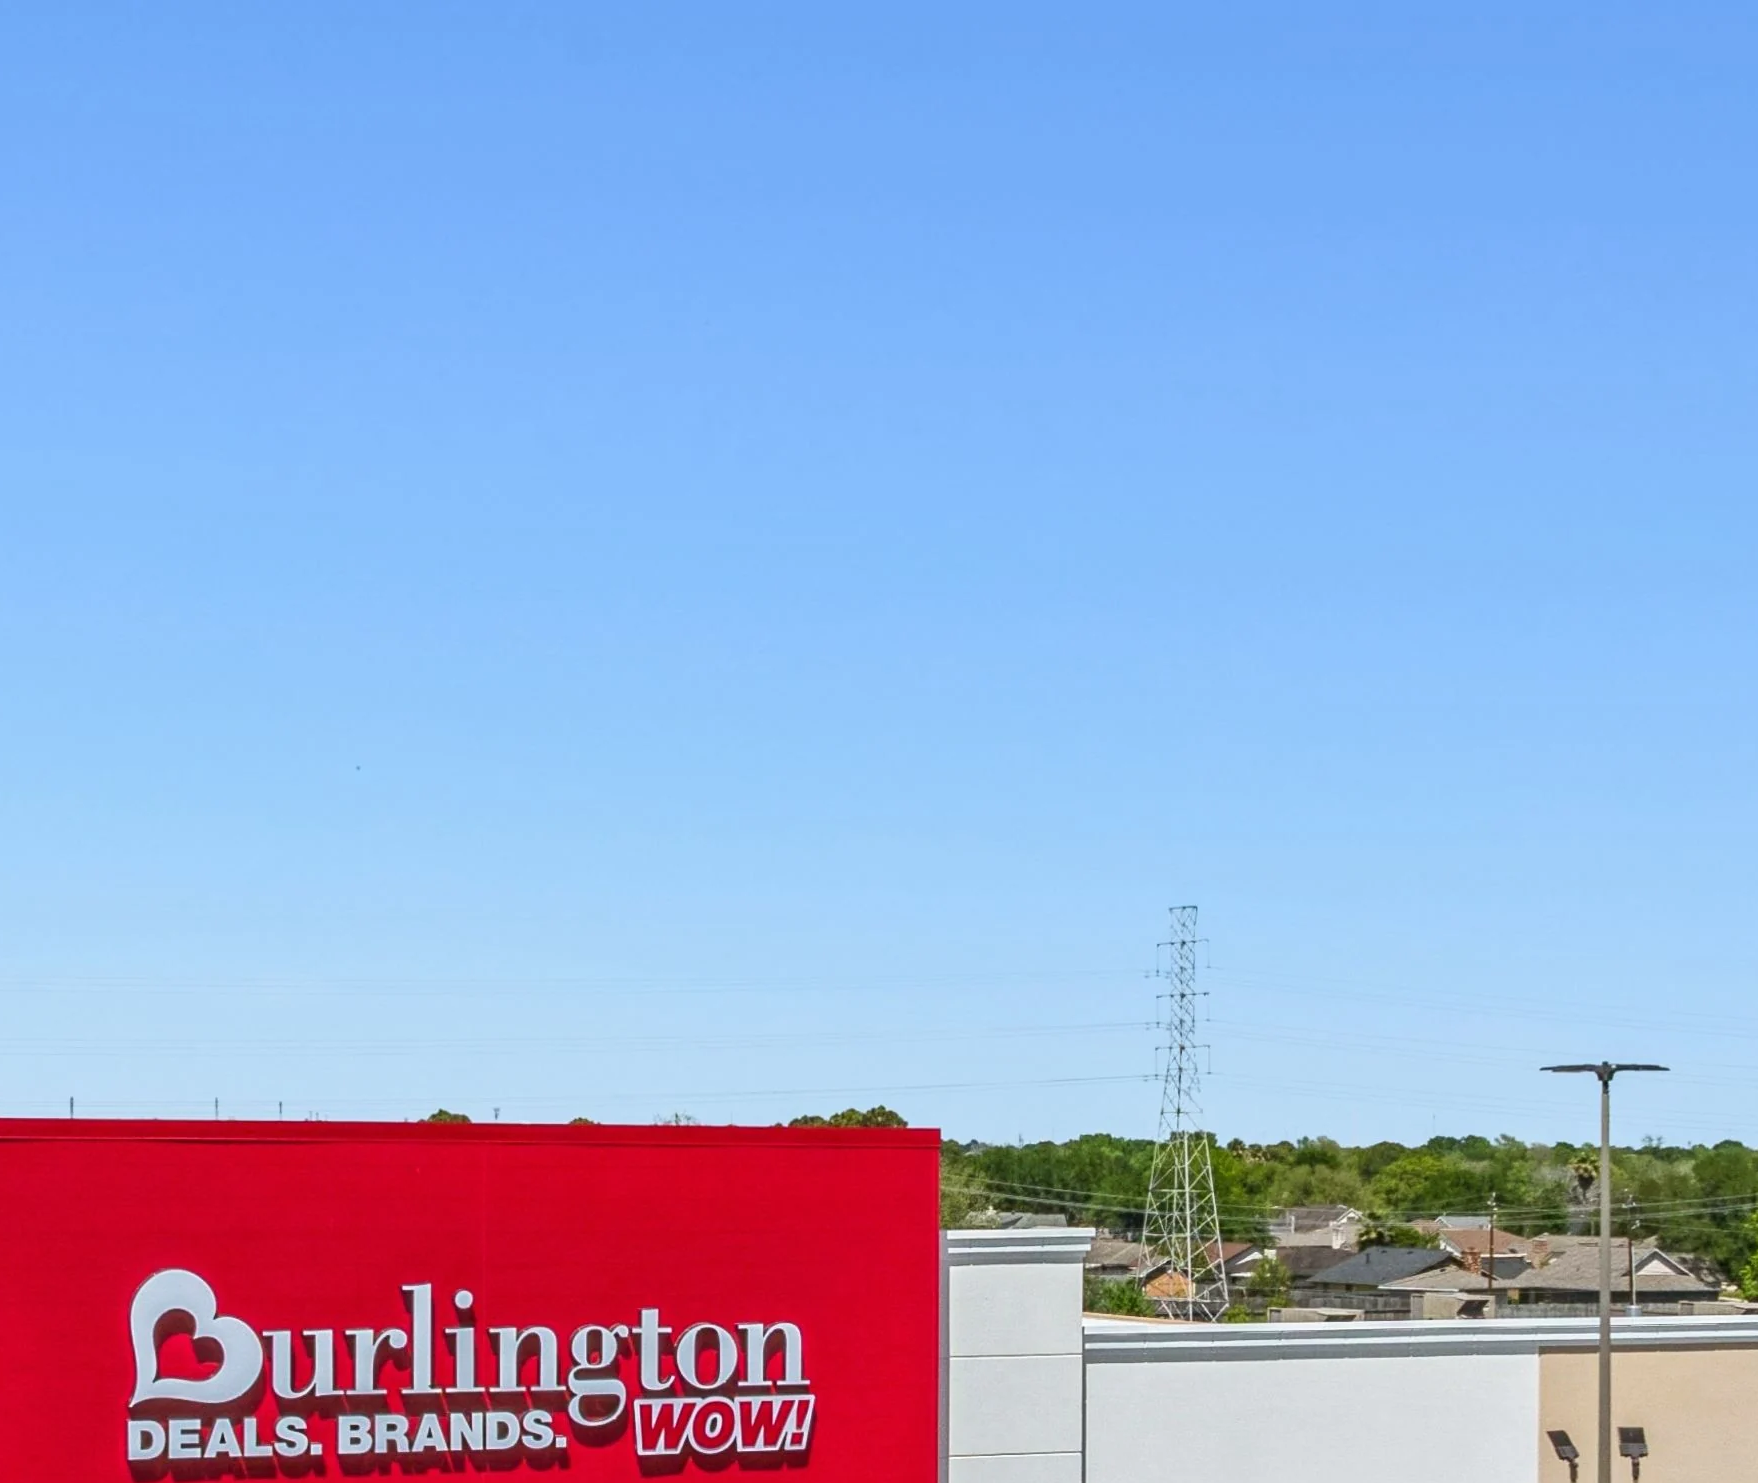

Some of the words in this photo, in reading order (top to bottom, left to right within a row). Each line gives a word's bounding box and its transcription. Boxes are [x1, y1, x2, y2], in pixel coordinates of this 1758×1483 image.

[129, 1269, 811, 1426] Burlington
[127, 1416, 323, 1461] DEALS.
[337, 1410, 567, 1454] BRANDS.
[634, 1394, 816, 1456] WOW!
